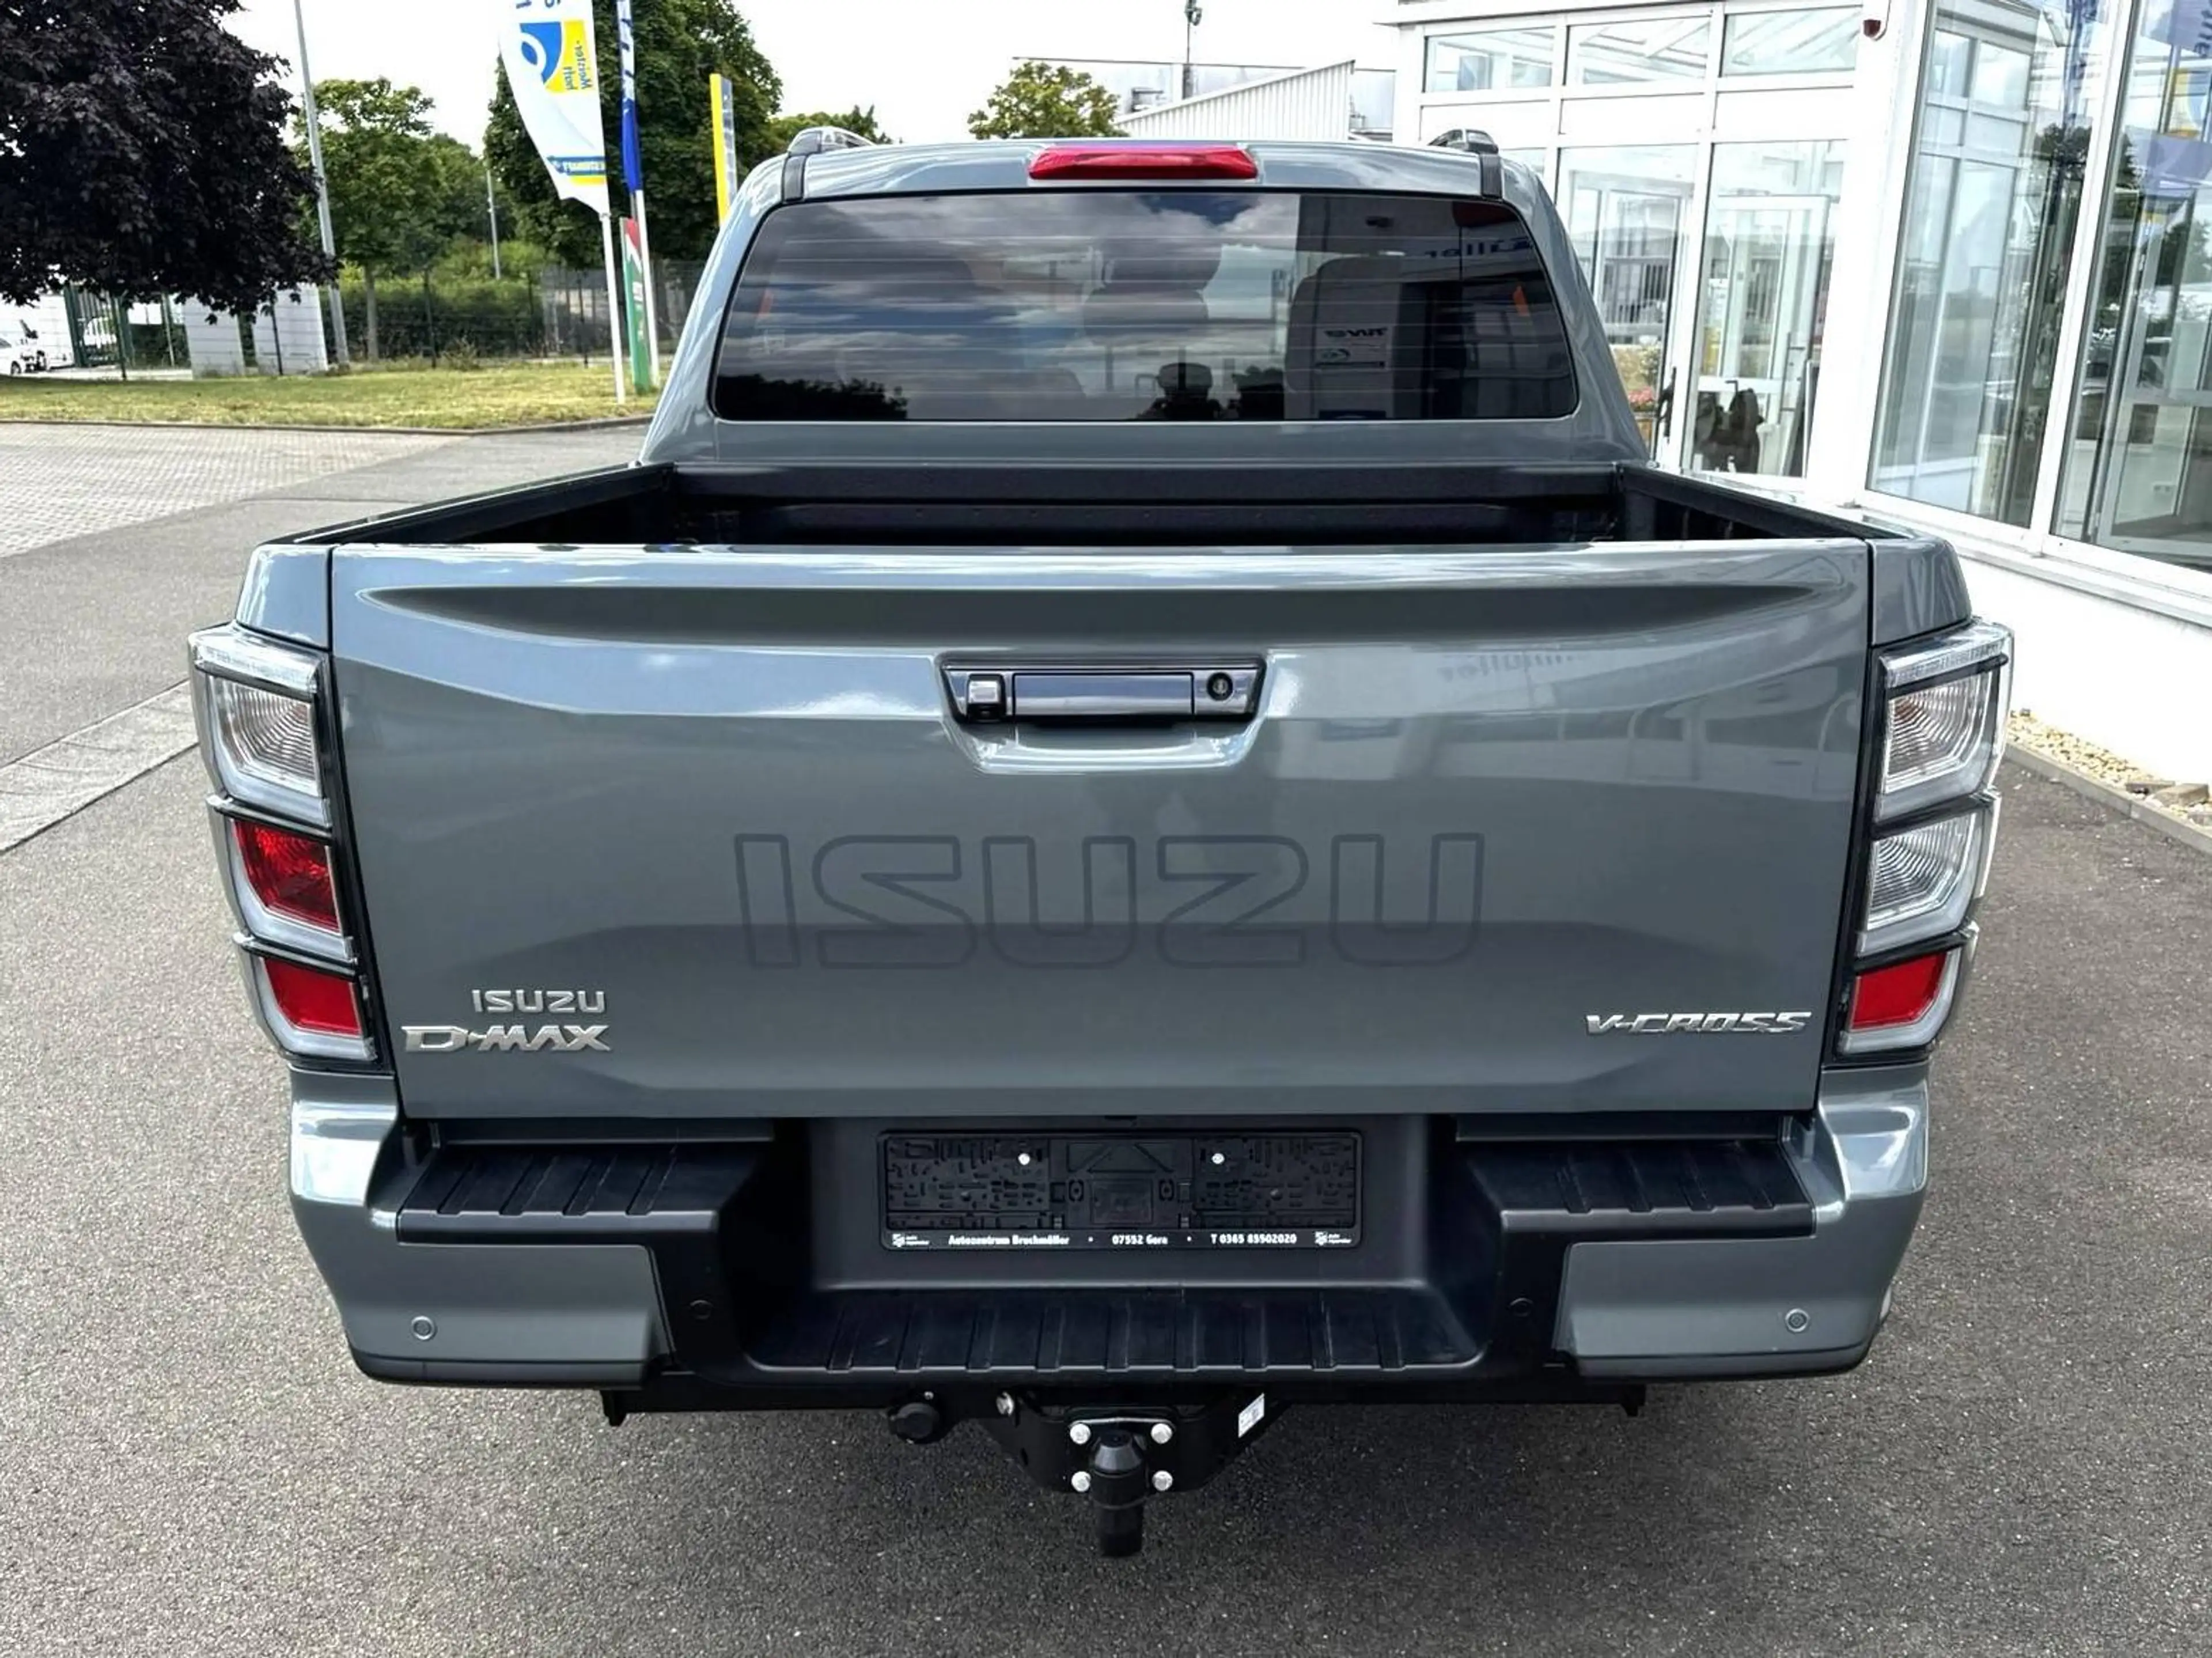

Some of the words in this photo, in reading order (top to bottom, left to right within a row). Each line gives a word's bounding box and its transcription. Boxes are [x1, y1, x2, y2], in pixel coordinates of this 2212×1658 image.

[734, 834, 1486, 969] ISUZU
[472, 989, 605, 1013] ISUZU
[1586, 1012, 1812, 1034] V-CROSS
[401, 1025, 611, 1051] D-MAX
[1211, 1233, 1218, 1245] T
